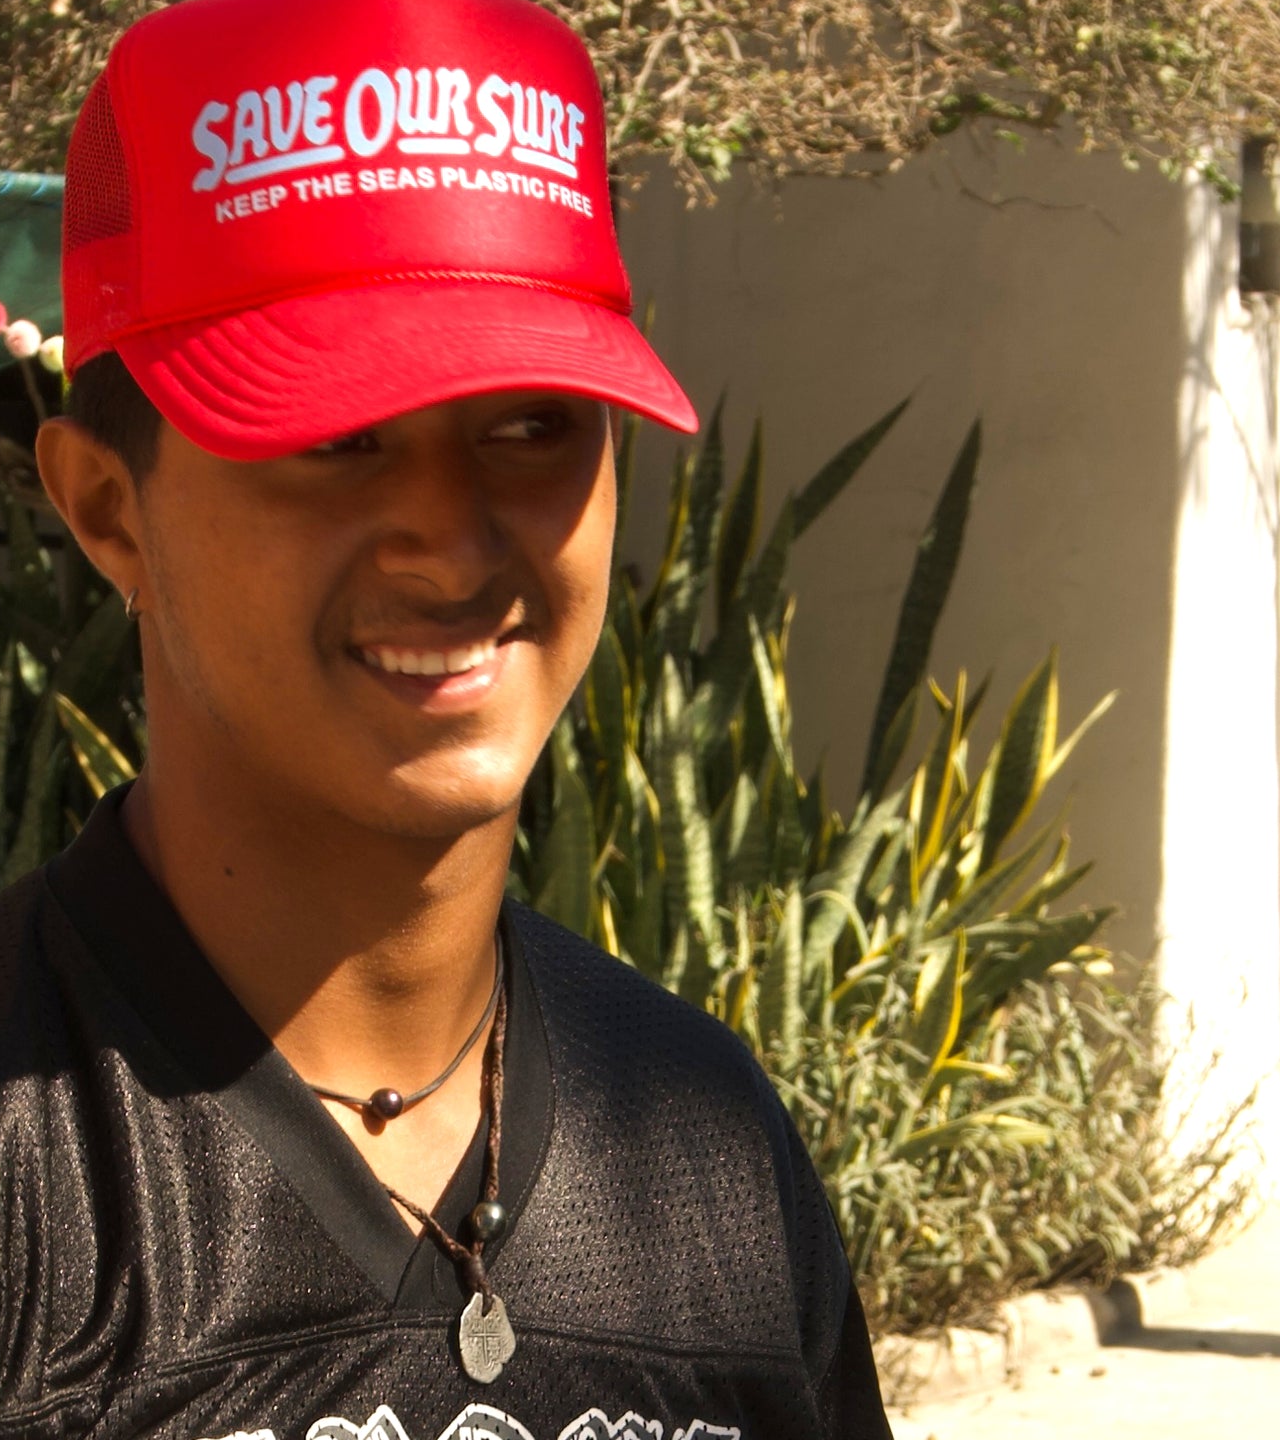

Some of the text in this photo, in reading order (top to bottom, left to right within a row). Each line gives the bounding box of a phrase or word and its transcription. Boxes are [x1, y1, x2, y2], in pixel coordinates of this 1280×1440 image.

[192, 67, 584, 192] SAVE OUR SURF
[215, 167, 593, 223] KEEP THE SEAS PLASTIC FREE
